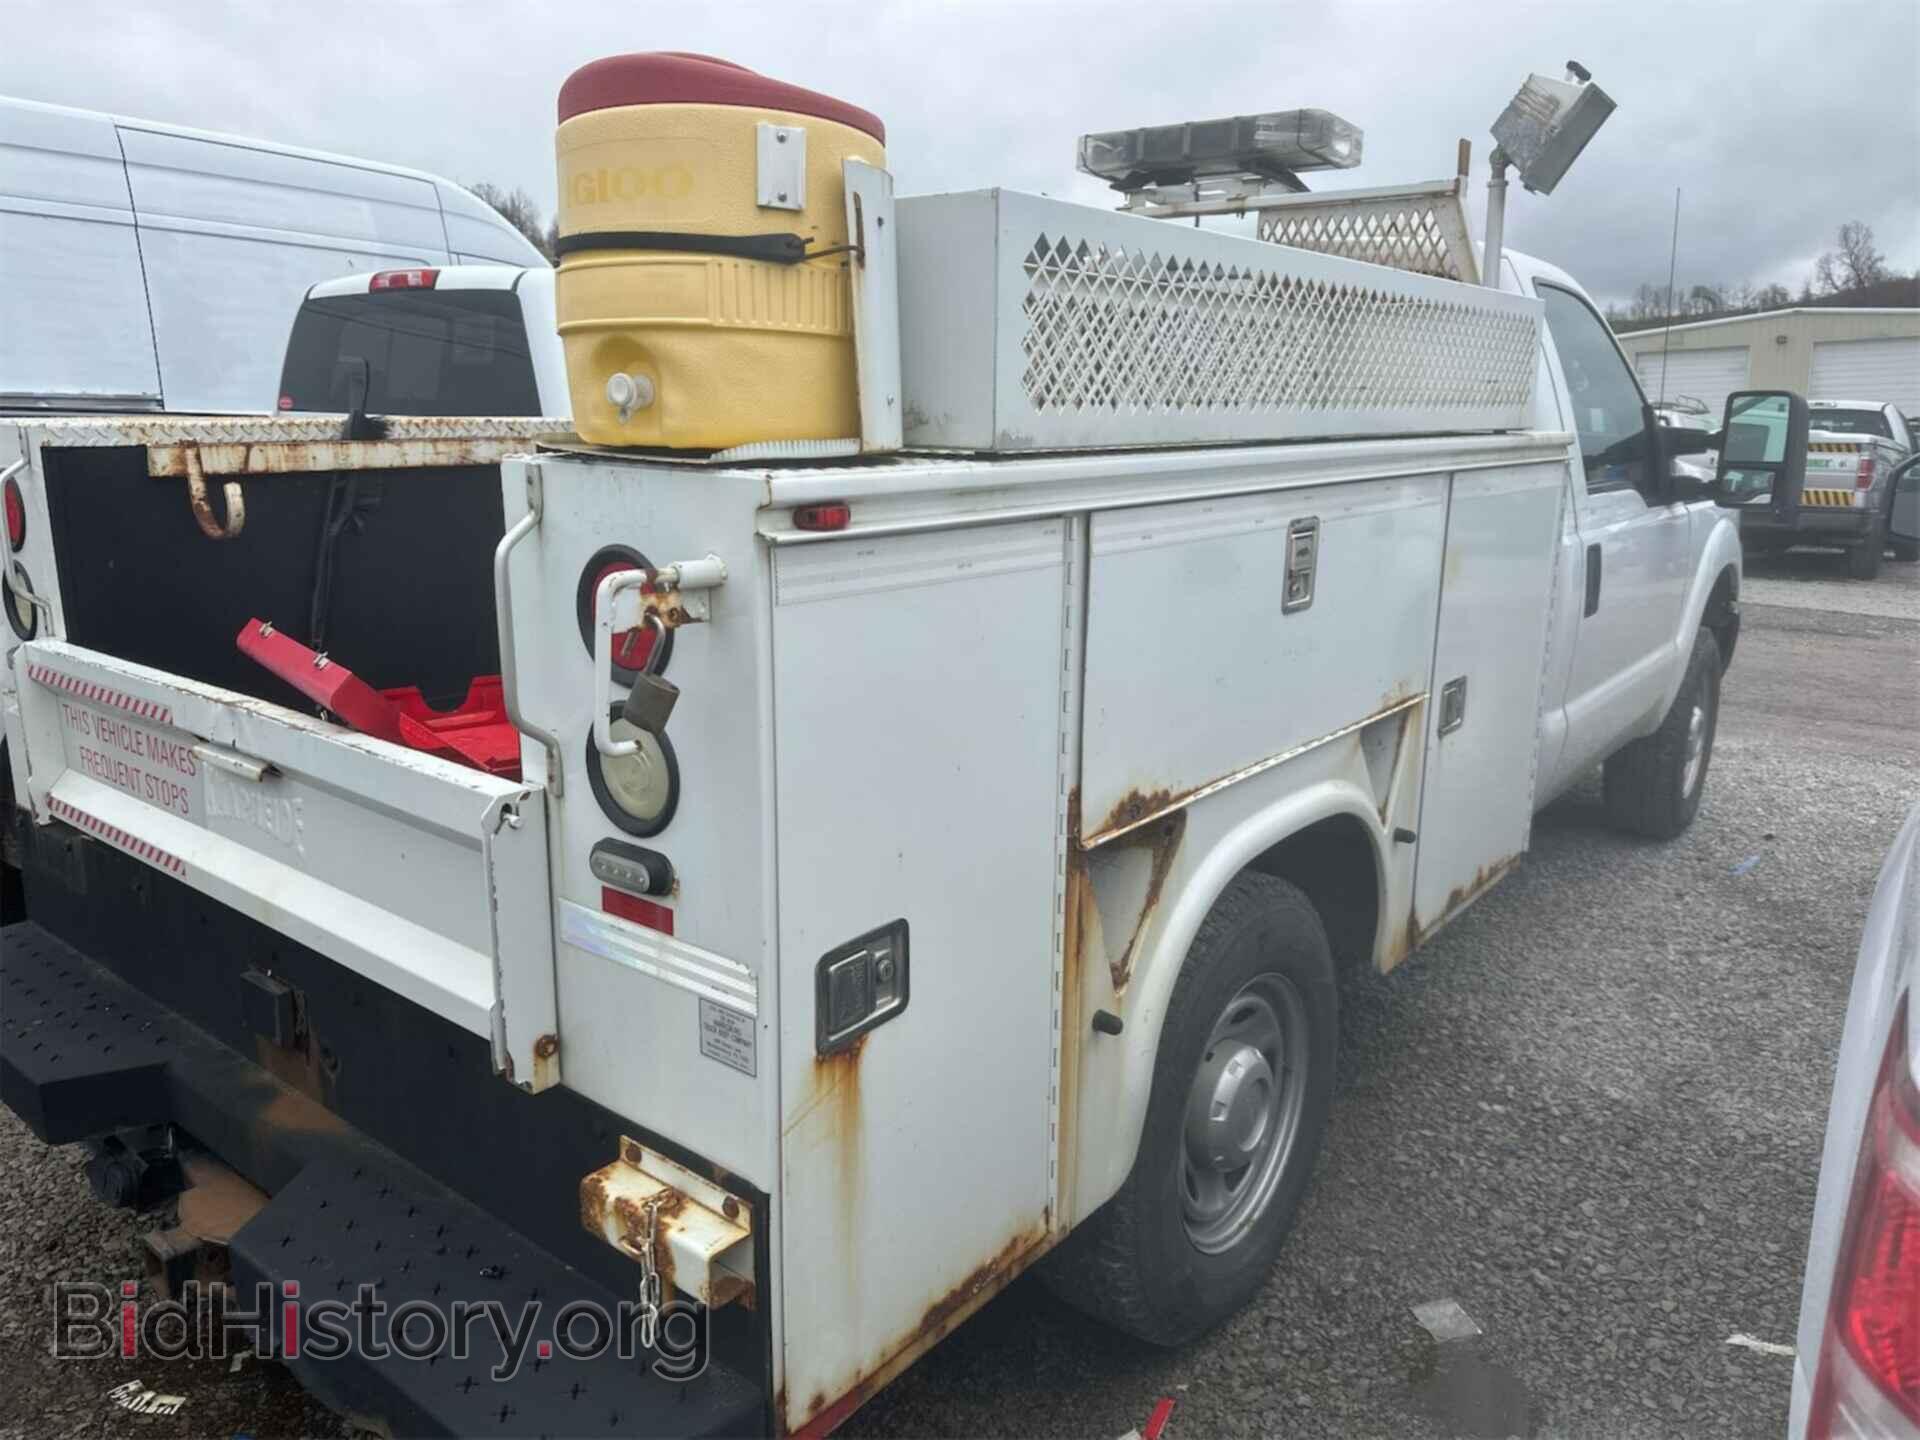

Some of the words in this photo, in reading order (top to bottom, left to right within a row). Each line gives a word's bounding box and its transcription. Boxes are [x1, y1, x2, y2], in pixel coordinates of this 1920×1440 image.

[62, 703, 91, 735] THIS
[91, 713, 144, 756] VEHICLE
[146, 734, 197, 777] MAKES
[80, 746, 141, 793] FREQUENT
[145, 772, 189, 815] STOPS
